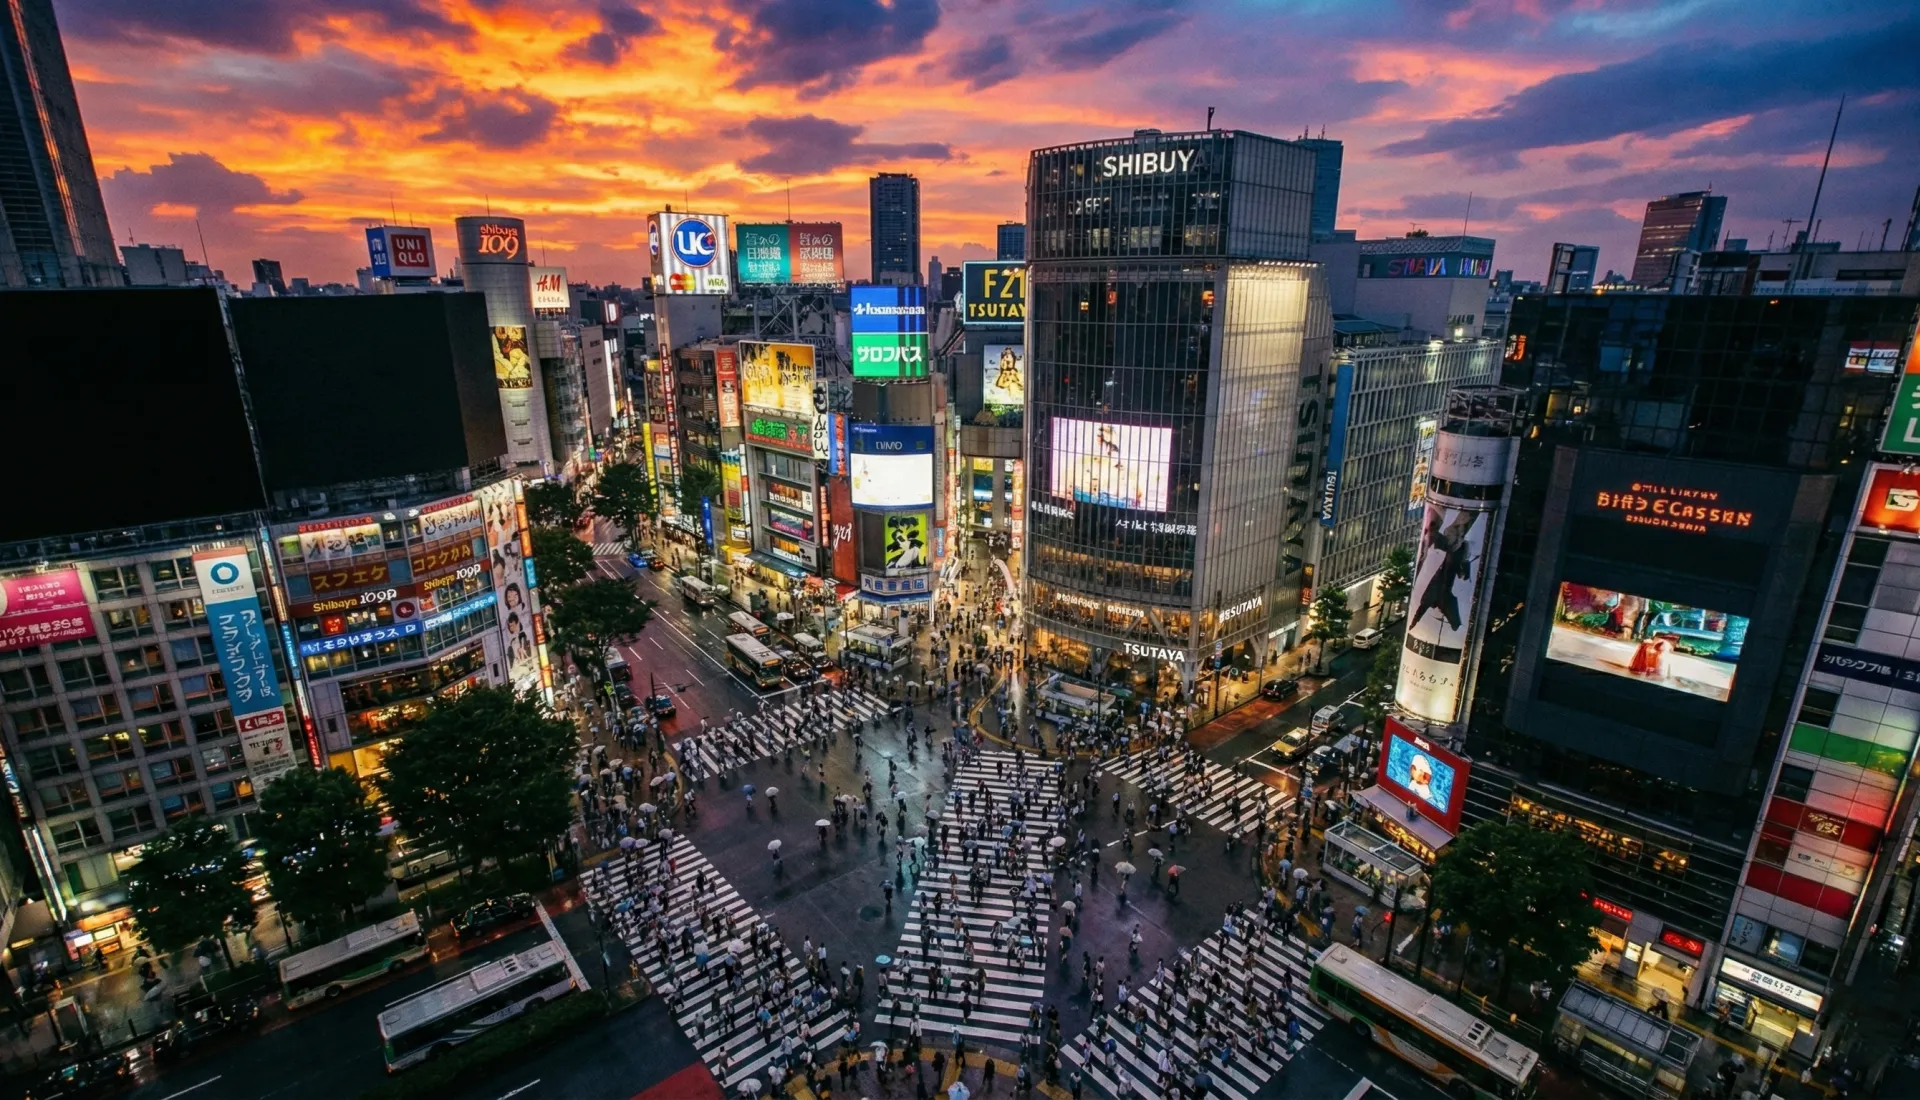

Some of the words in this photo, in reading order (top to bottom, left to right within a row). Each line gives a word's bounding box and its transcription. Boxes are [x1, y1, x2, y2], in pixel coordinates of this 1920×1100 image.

[396, 238, 421, 250] UNI
[478, 235, 519, 260] 109
[398, 252, 425, 265] QLO
[1122, 642, 1186, 662] TSUTAYA
